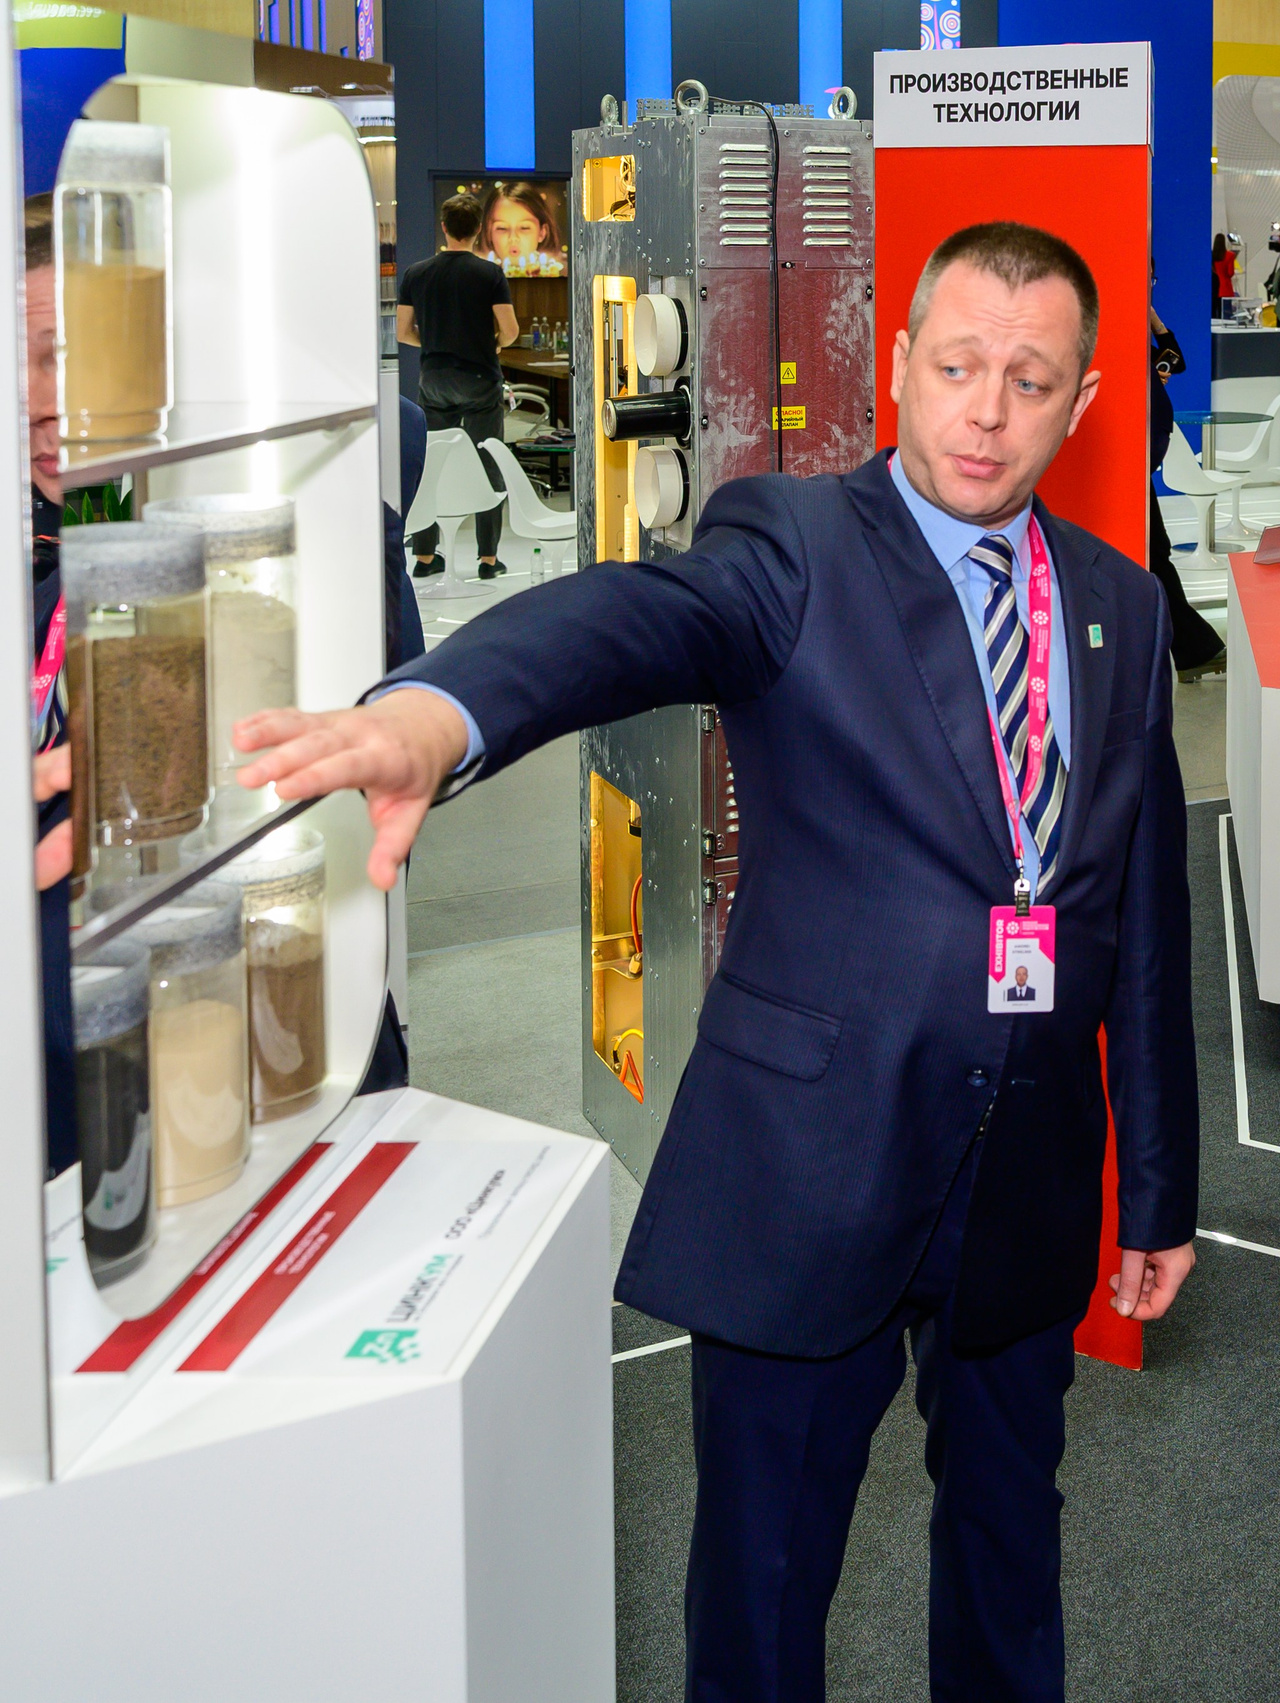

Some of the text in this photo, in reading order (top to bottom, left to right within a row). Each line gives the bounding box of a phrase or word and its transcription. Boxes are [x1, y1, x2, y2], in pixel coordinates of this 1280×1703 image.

[889, 67, 1129, 95] ПРОИЗВОДСТВЕННЫЕ
[932, 100, 1080, 123] ТЕХНОЛОГИИ
[995, 919, 1004, 972] EXHIBITOR
